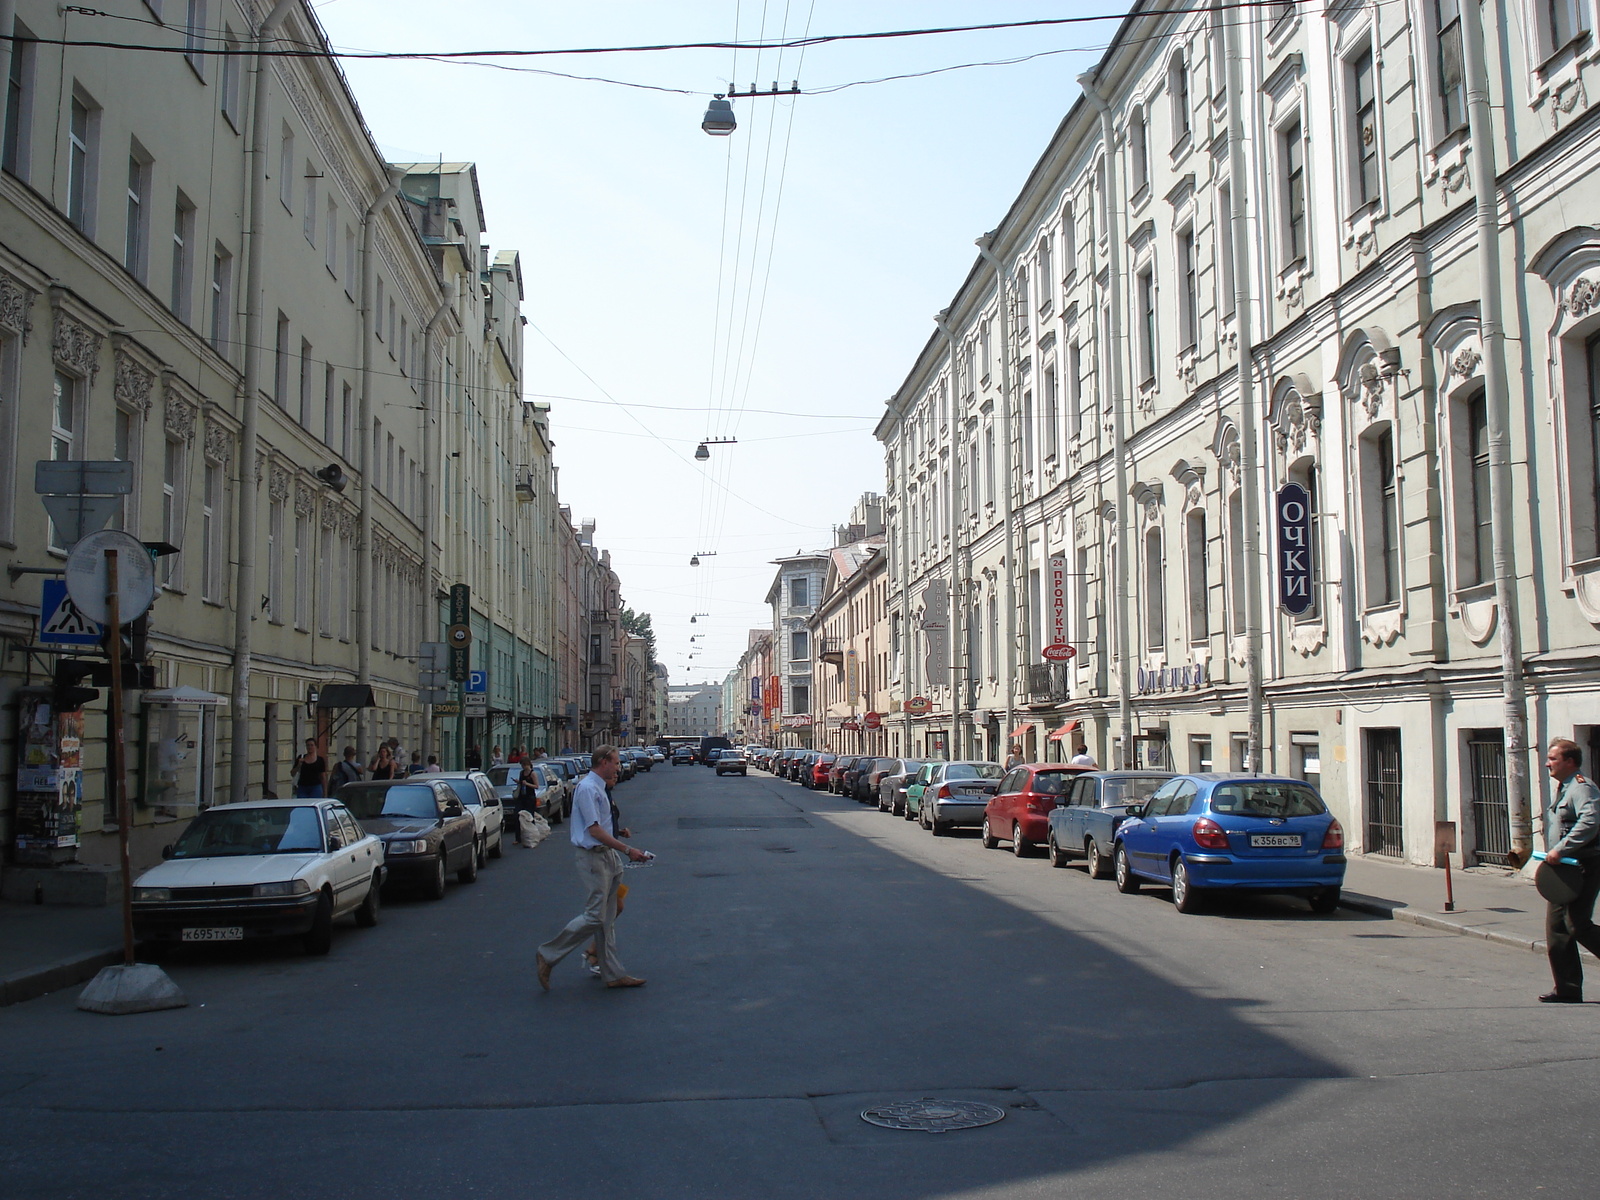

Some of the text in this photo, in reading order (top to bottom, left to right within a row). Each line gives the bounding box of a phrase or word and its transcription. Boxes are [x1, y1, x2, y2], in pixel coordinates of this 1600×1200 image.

[1282, 501, 1308, 597] ОЧКИ
[935, 580, 943, 616] САЛОН
[1053, 570, 1065, 644] ПРОДУКТЫ
[936, 633, 944, 683] КРАСОТЫ
[1137, 663, 1202, 692] Оптика
[469, 673, 482, 690] P
